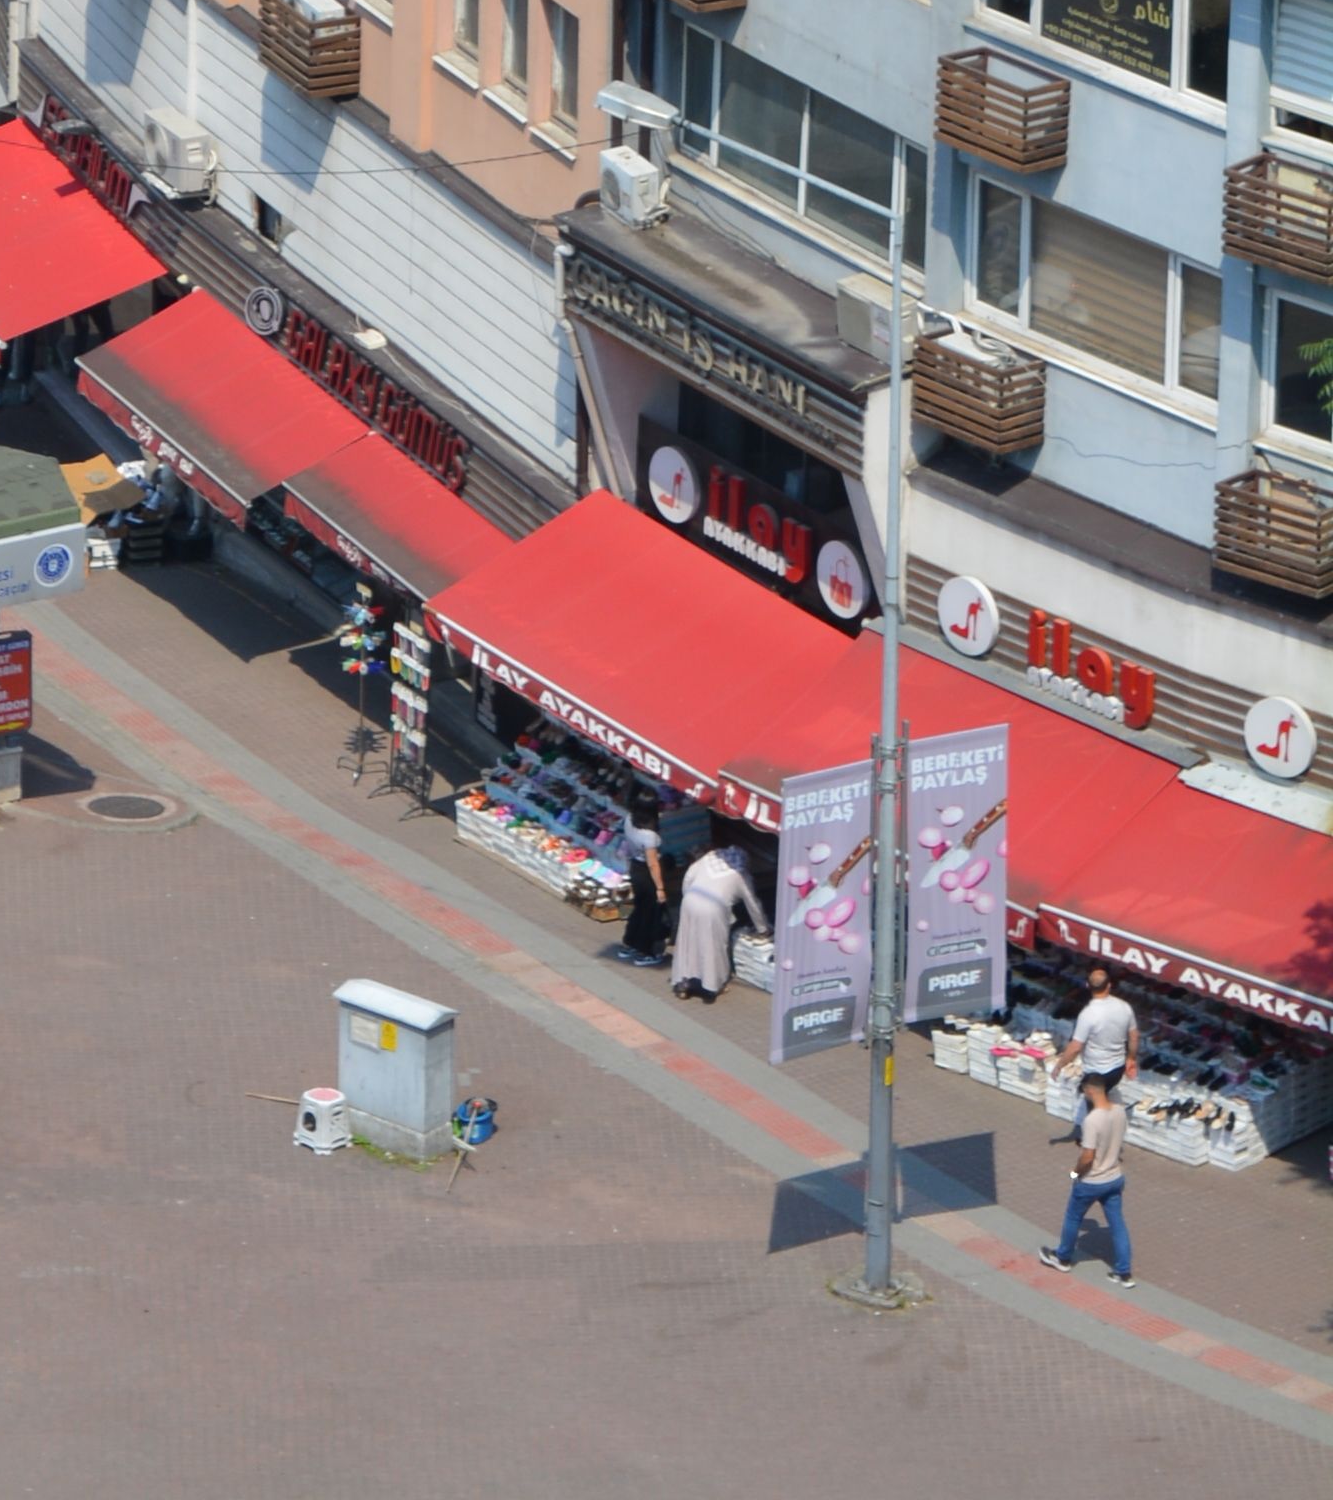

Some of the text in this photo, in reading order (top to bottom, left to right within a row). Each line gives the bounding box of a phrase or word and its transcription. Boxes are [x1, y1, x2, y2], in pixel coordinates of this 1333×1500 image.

[286, 308, 378, 418] GALAXY
[708, 462, 814, 585] ilay
[470, 643, 671, 782] İLAY AYAKKABI
[1028, 608, 1155, 730] ilay
[1088, 929, 1170, 975] İLAY
